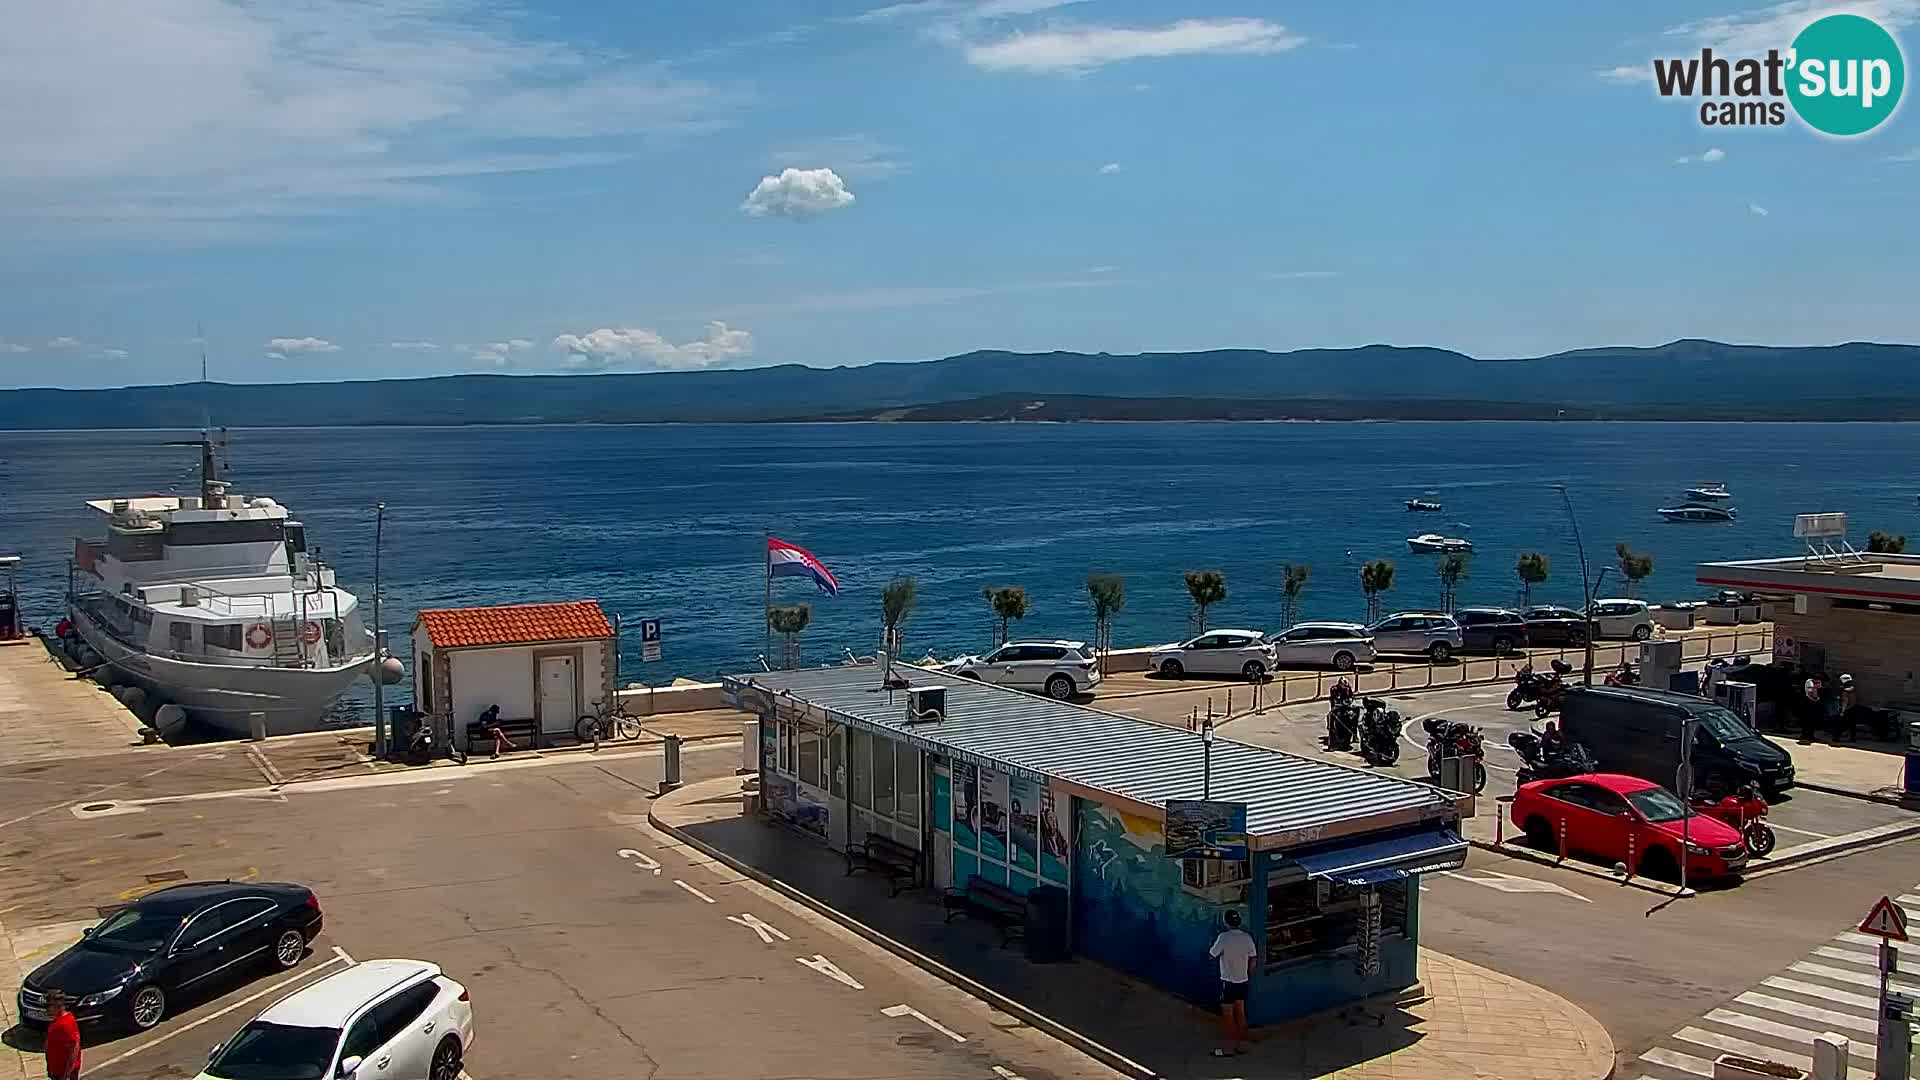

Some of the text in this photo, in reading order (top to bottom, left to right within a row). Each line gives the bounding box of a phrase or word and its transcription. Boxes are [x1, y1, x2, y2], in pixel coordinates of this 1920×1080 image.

[646, 622, 656, 639] P
[947, 746, 961, 760] BUS
[962, 752, 992, 769] STATION
[994, 761, 1018, 777] TICKET
[1020, 769, 1045, 784] OFFICE
